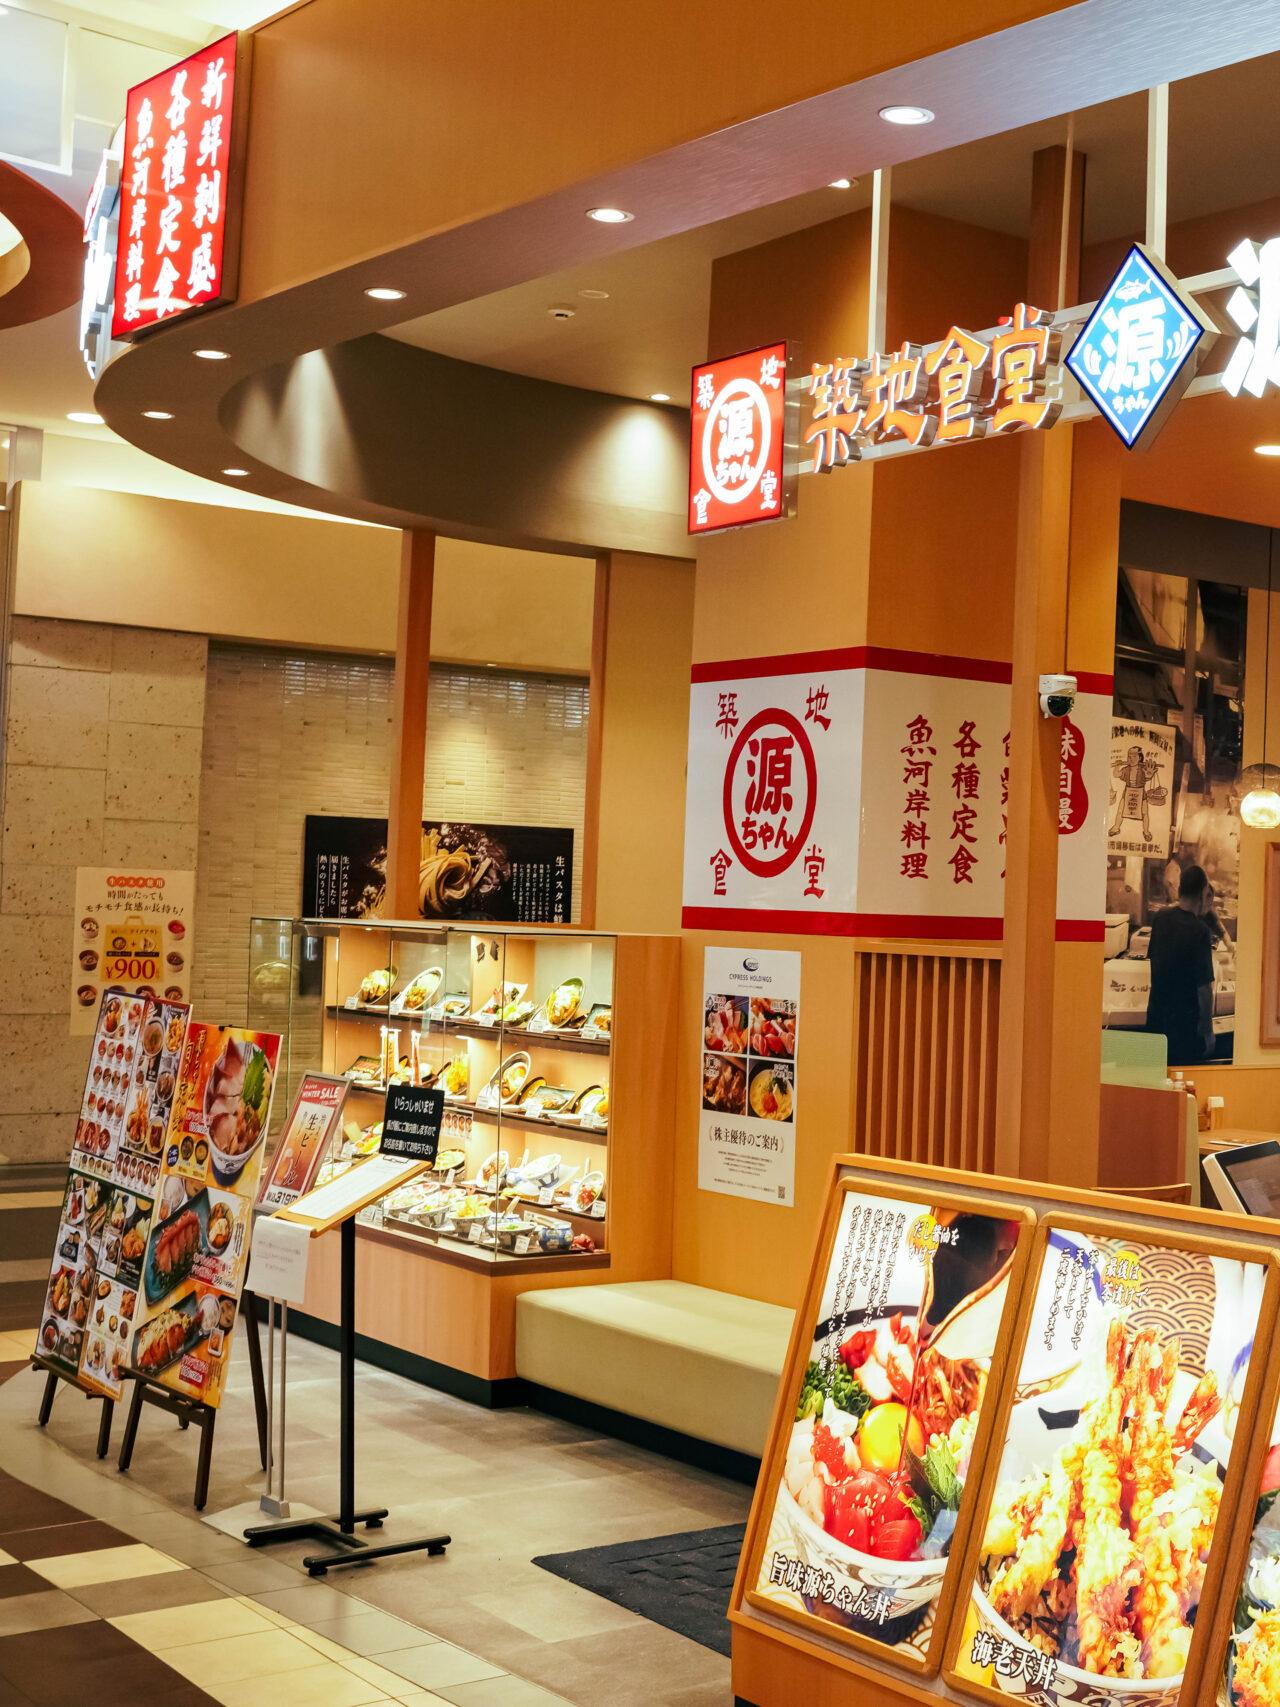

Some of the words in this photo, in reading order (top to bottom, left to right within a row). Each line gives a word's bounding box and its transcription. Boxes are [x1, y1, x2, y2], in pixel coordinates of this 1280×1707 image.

[153, 69, 190, 318] 各種定食
[187, 57, 226, 299] 新鮮刺盛
[1100, 297, 1168, 393] 源
[804, 303, 1050, 474] 築地食堂
[1111, 393, 1151, 414] ちゃん
[719, 400, 755, 460] 源
[716, 460, 756, 484] ちゃん
[744, 735, 794, 816] 源
[900, 714, 937, 880] 魚河岸料理
[948, 720, 982, 885] 各種定食
[741, 818, 794, 851] ちゃん
[107, 890, 164, 901] 時間がたっても
[320, 1086, 340, 1100] SALE
[394, 1096, 435, 1115] いらっしゃいませ
[1106, 1257, 1140, 1280] 最後は
[769, 1552, 893, 1625] 旨味源ちゃん丼
[970, 1630, 1058, 1690] 海老天丼
